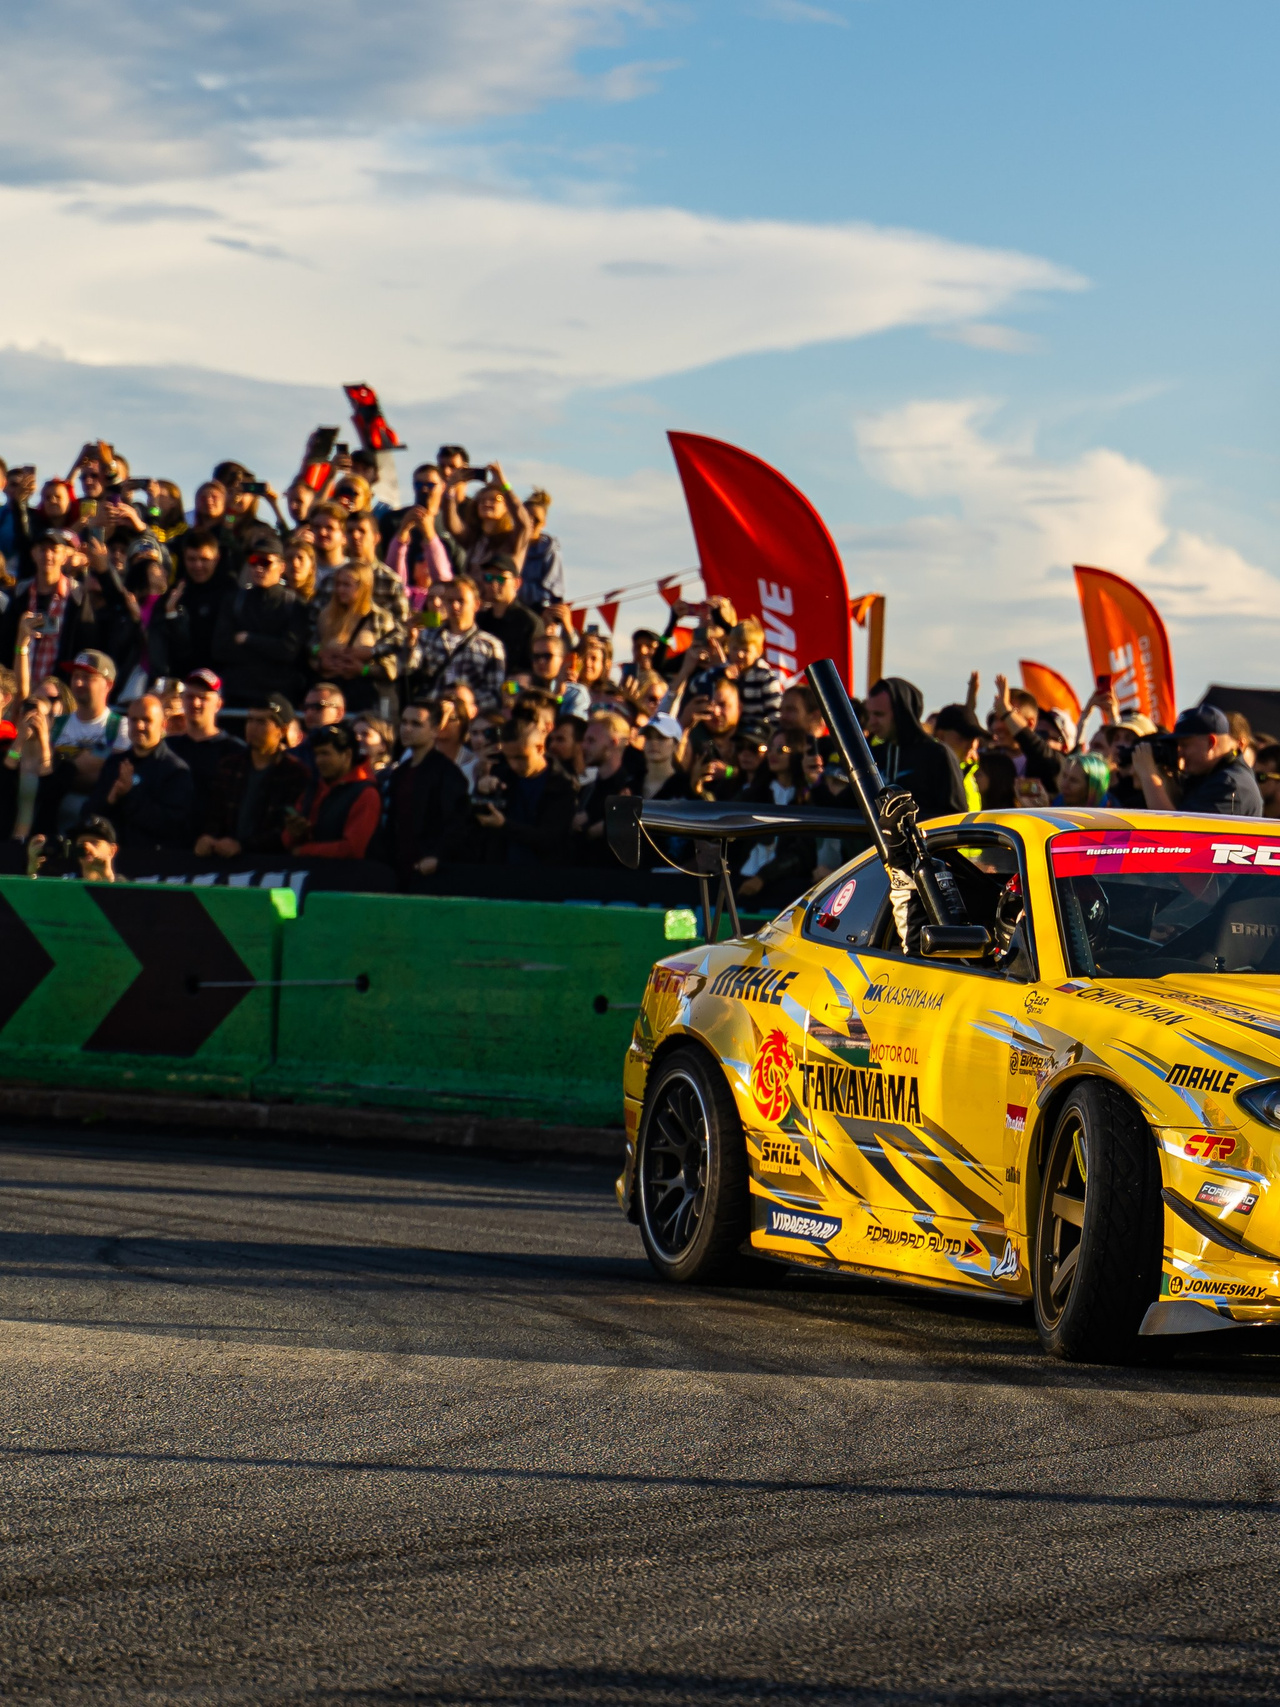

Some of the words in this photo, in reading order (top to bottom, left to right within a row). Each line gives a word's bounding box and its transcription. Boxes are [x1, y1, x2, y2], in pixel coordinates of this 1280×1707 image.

[1086, 847, 1130, 855] Russian
[1131, 846, 1155, 854] Drift
[1156, 846, 1192, 854] Series
[709, 964, 799, 1006] MAHLE
[884, 985, 944, 1011] KASHIYAMA
[1077, 987, 1193, 1026] CHIVCHYAN
[870, 1043, 903, 1064] MOTOR
[904, 1047, 919, 1065] OIL
[1164, 1063, 1239, 1094] MAHLE
[798, 1063, 922, 1125] TAKAYAMA
[762, 1142, 801, 1166] SKILL
[772, 1211, 838, 1239] VIRAGE24.RU
[864, 1225, 926, 1248] FORWARD
[927, 1232, 964, 1256] AUTO
[1184, 1279, 1266, 1299] JONNESWAY
